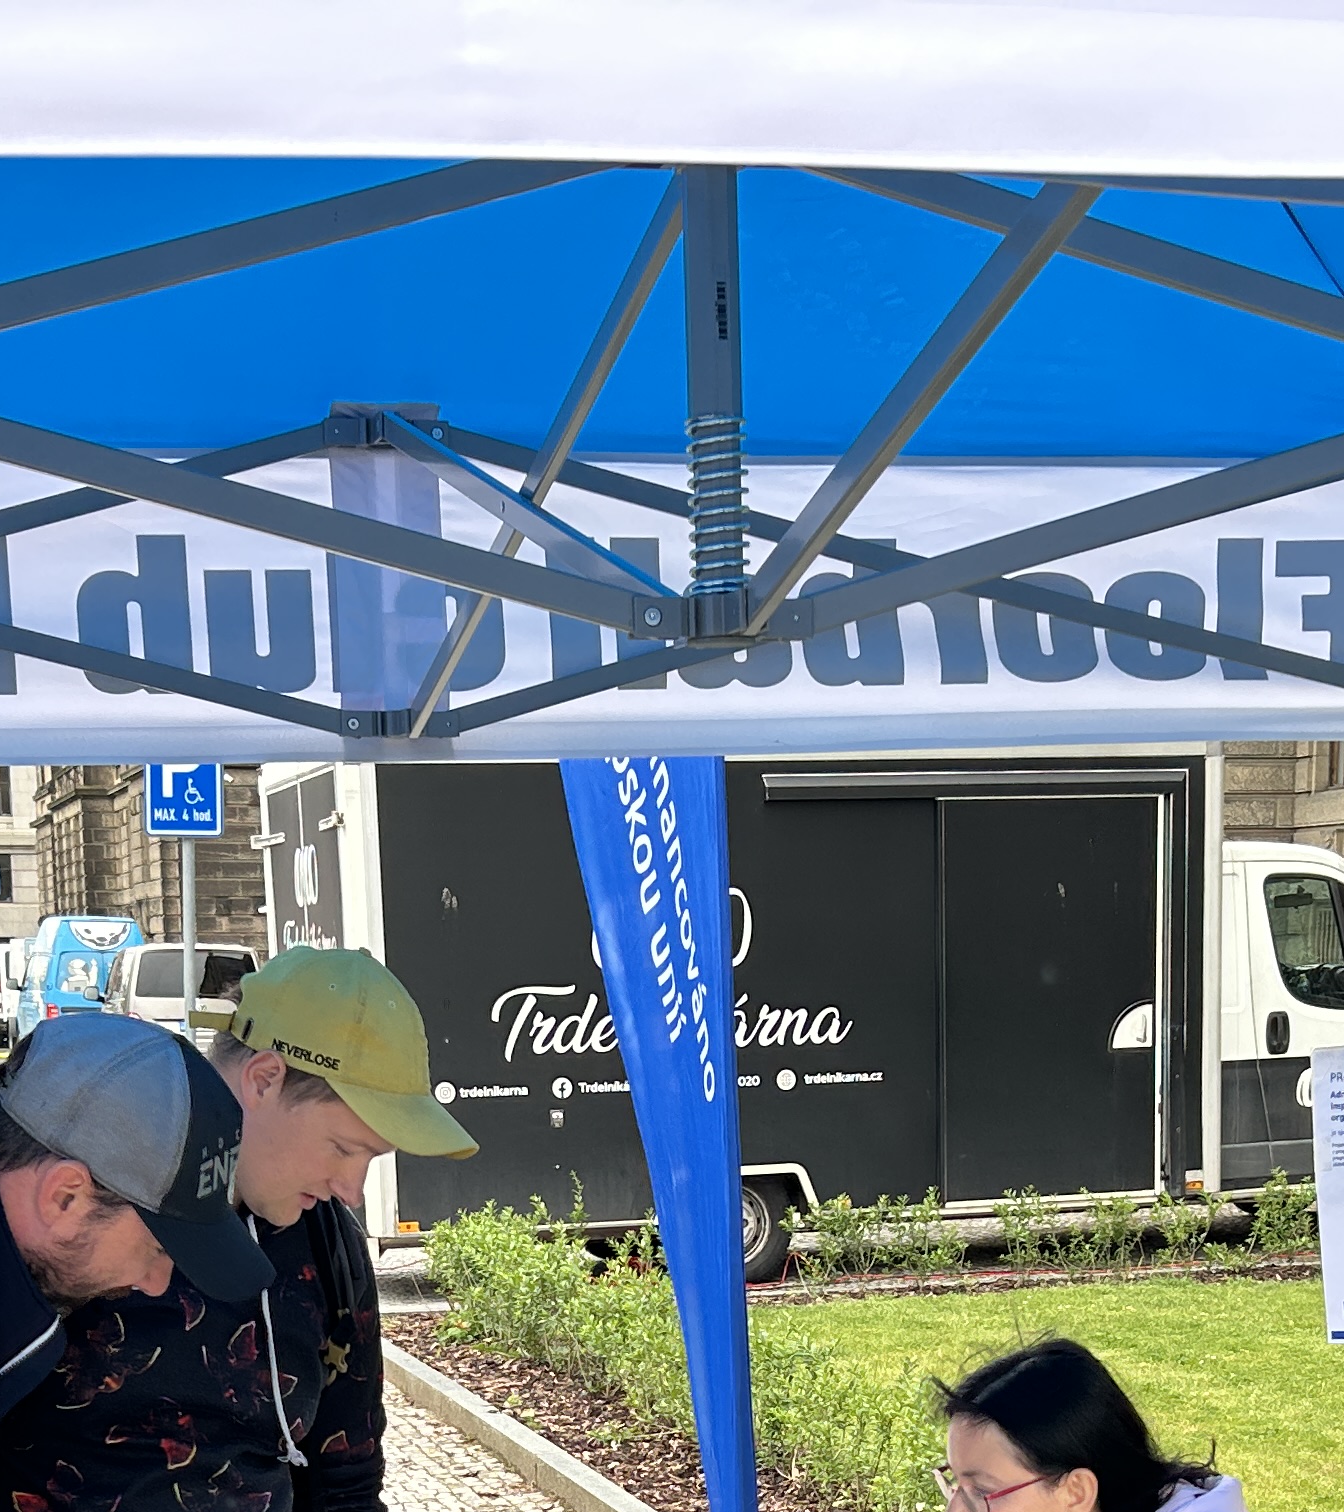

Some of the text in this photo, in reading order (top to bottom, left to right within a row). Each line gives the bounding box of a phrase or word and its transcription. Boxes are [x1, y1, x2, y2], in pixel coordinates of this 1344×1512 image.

[154, 808, 213, 822] MAX. 4 hod.
[490, 983, 854, 1063] Trdeárna
[271, 1037, 341, 1071] NEVERLOSE
